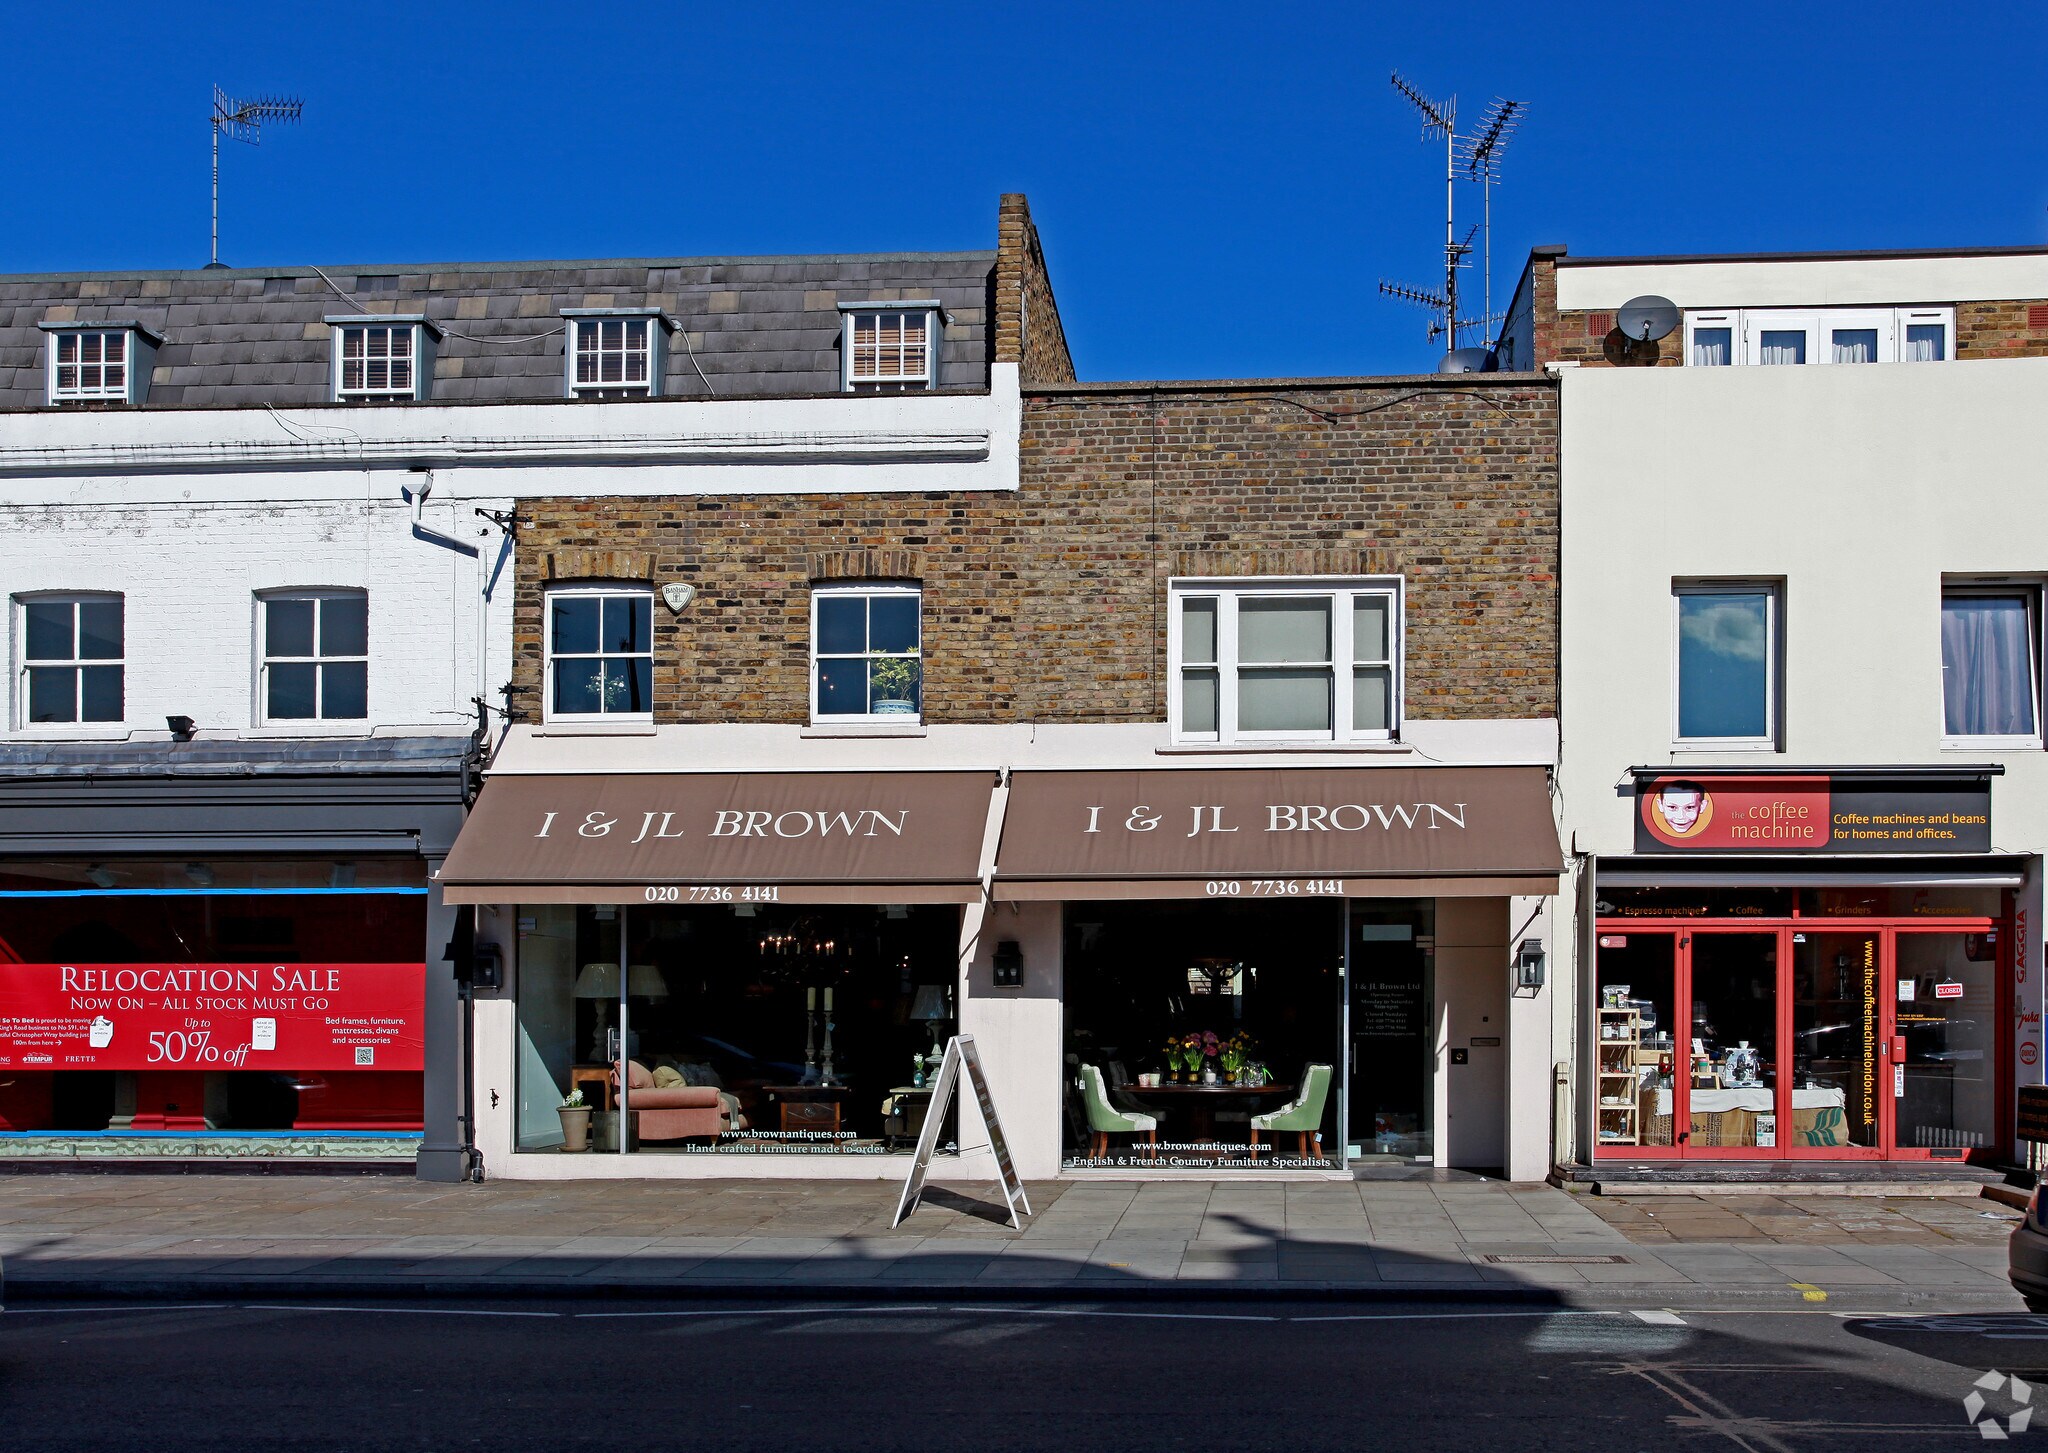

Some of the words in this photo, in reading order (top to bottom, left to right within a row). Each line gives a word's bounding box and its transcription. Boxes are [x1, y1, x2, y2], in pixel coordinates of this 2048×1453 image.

[1749, 802, 1808, 819] coffee
[1083, 806, 1104, 833] I
[1125, 806, 1163, 832] &
[1187, 806, 1239, 838] JL
[1264, 803, 1468, 832] BROWN
[1834, 814, 1869, 824] Coffee
[1872, 814, 1925, 824] machines
[1928, 814, 1948, 824] and
[1952, 814, 1986, 824] beans
[535, 812, 558, 838] I
[578, 811, 618, 838] &
[631, 812, 684, 844] JL
[708, 810, 910, 838] BROWN
[1731, 821, 1814, 838] machine
[1834, 829, 1849, 839] for
[1852, 829, 1889, 839] homes
[1892, 829, 1913, 839] and
[1916, 828, 1956, 839] offices.
[1206, 881, 1240, 895] 020
[1251, 880, 1298, 895] 7736
[1306, 880, 1344, 895] 4141
[645, 886, 678, 902] 020
[689, 886, 732, 901] 7736
[741, 886, 779, 901] 4141
[1624, 906, 1663, 916] Espresso
[1665, 906, 1705, 914] machines
[1736, 906, 1763, 914] Coffee
[1834, 906, 1871, 914] Grinders
[1921, 906, 1972, 914] Accessories
[2016, 909, 2025, 984] GAGGIA
[185, 1018, 198, 1029] Up
[200, 1019, 211, 1028] to
[342, 1017, 369, 1025] frames,
[370, 1017, 406, 1025] furniture,
[2017, 1007, 2039, 1029] jura
[1864, 940, 1875, 1125] www.thecoffeemachinelondon.co.uk
[147, 1031, 218, 1063] 50%
[223, 1043, 251, 1066] off
[721, 1129, 857, 1141] www.brownantiques.com
[686, 1144, 715, 1153] Hand
[720, 1144, 756, 1153] crafted
[759, 1144, 807, 1153] furniture
[811, 1144, 840, 1153] made
[1132, 1141, 1272, 1154] www.brownantiques.com
[1073, 1157, 1114, 1169] English
[1117, 1157, 1127, 1166] &
[1130, 1157, 1166, 1166] French
[1170, 1157, 1214, 1168] Country
[1217, 1157, 1269, 1167] Furniture
[1272, 1157, 1331, 1169] Specialists
